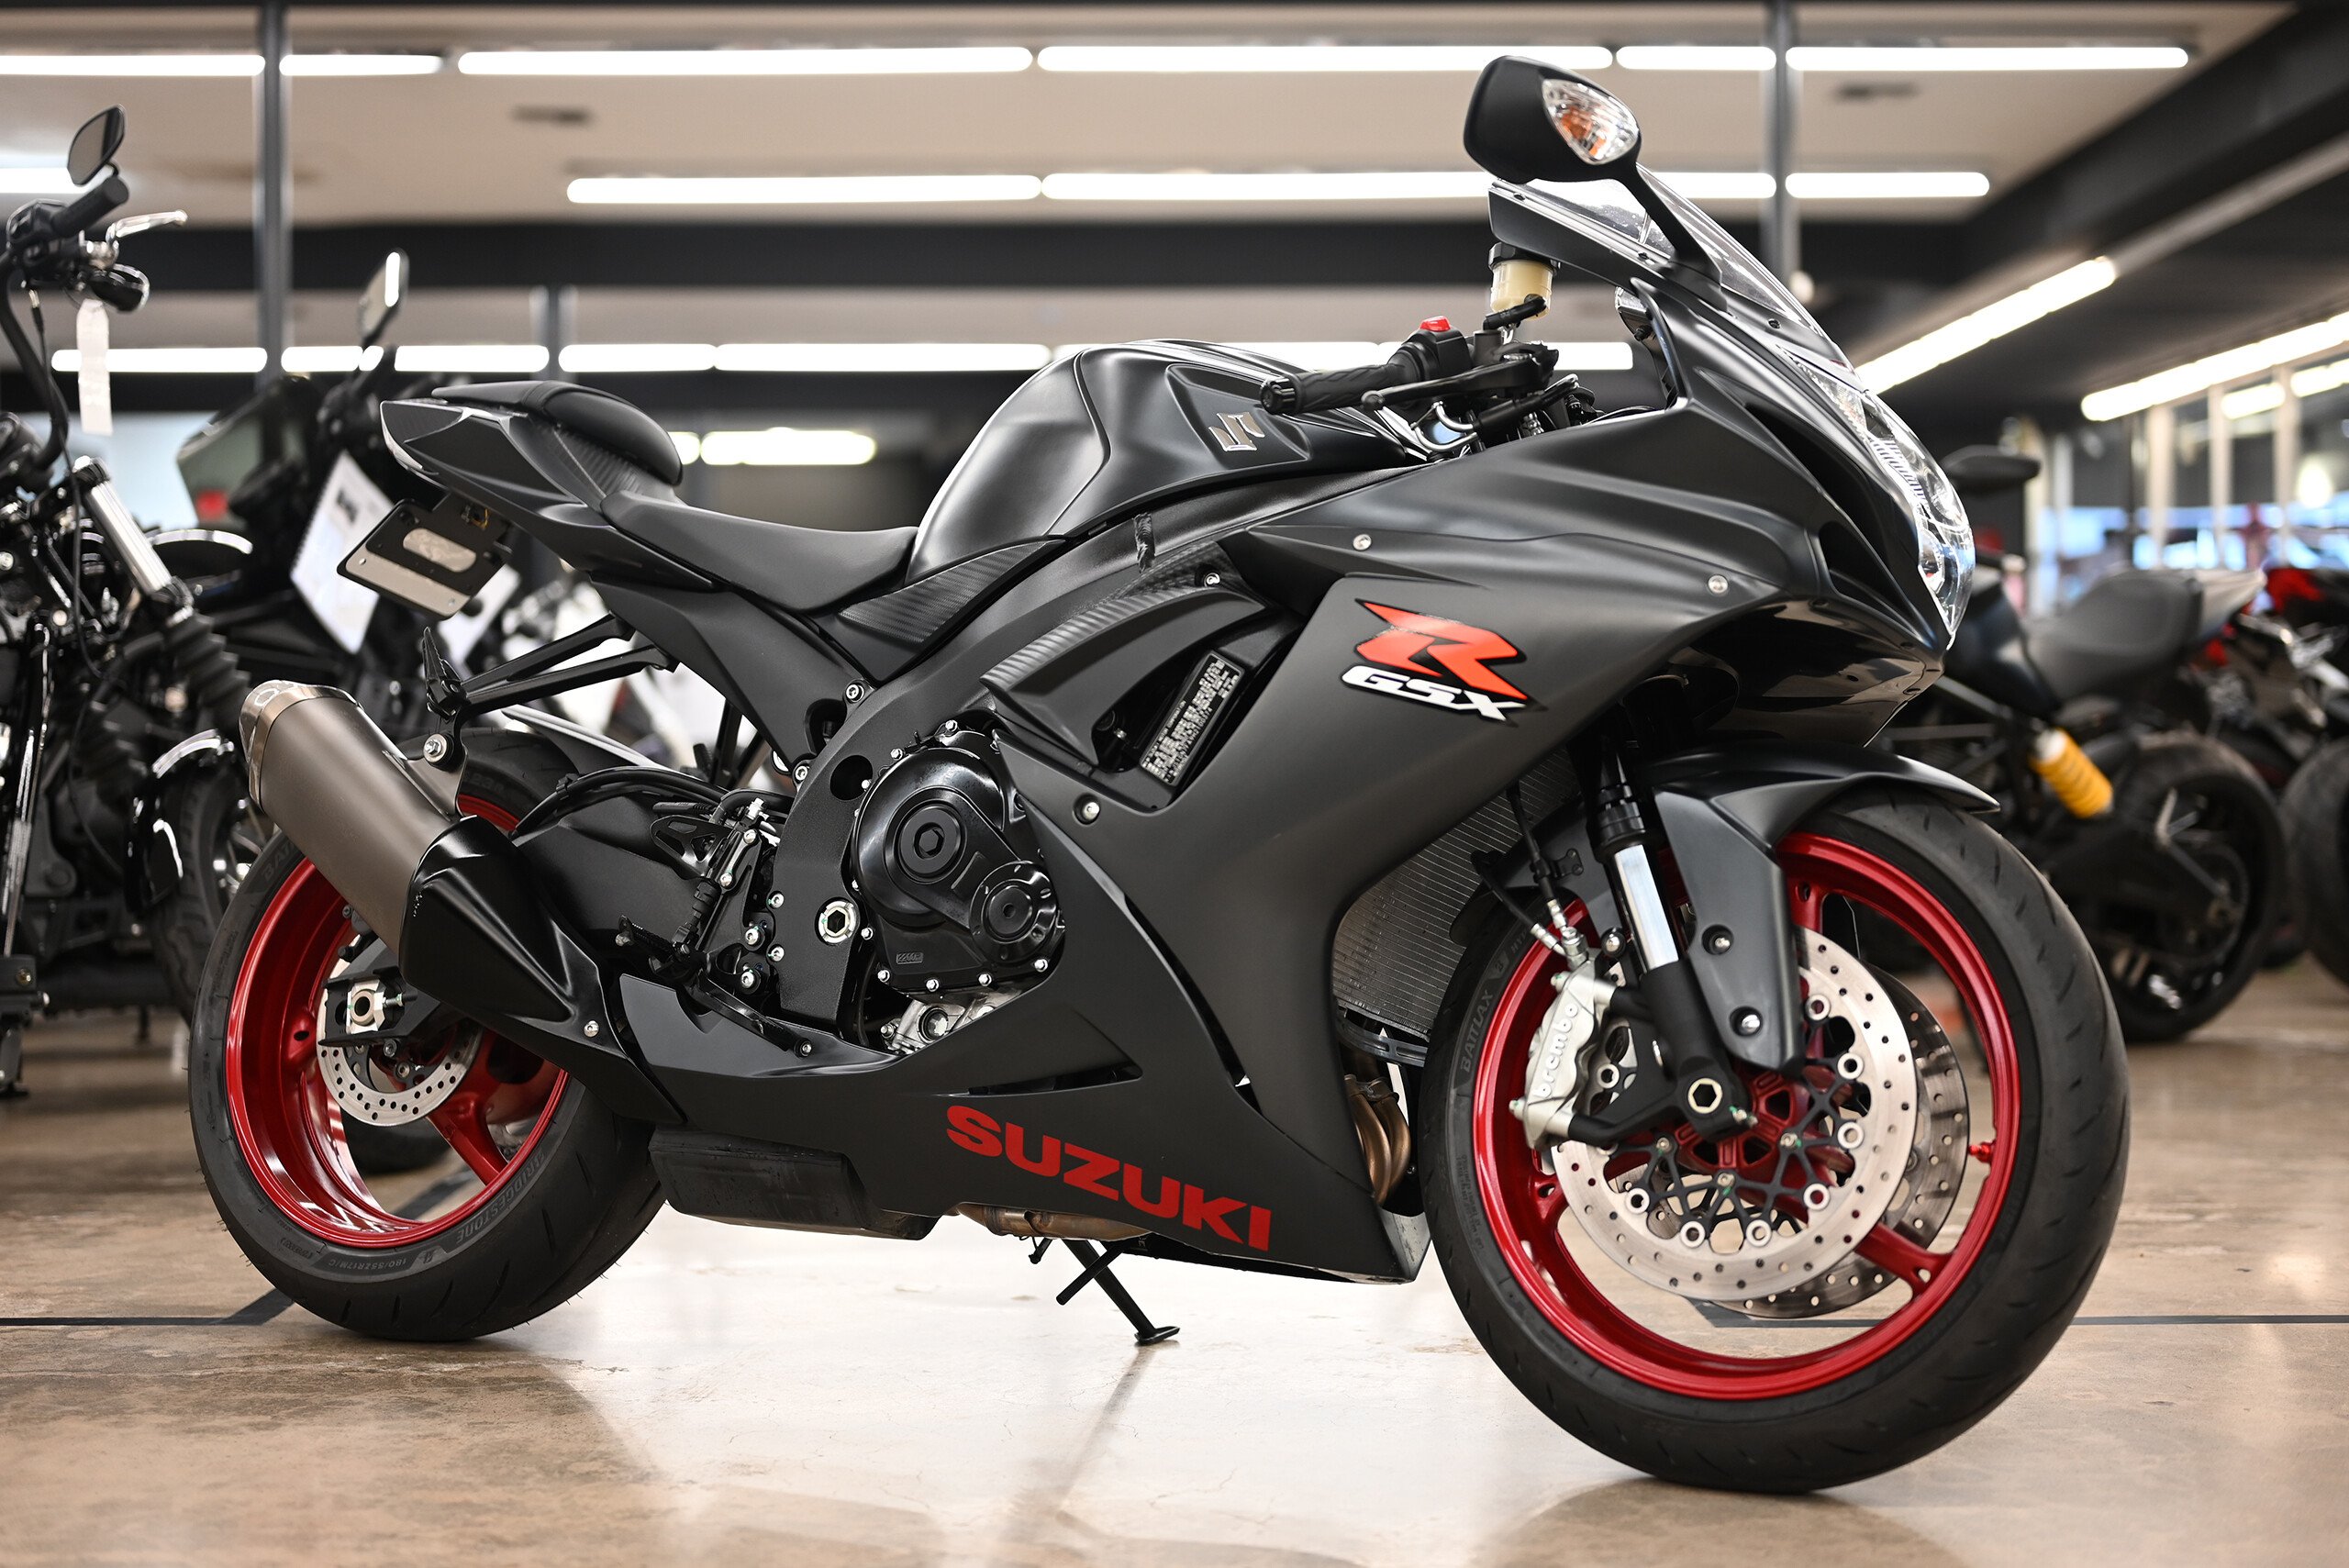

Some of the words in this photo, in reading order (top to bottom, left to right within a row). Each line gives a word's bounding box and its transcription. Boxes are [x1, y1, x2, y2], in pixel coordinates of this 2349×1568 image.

[1341, 664, 1527, 722] GSX
[1357, 601, 1529, 701] R
[1461, 989, 1494, 1073] BATTLAX
[1531, 1002, 1579, 1098] brembo
[456, 1152, 546, 1242] BRIDGESTONE
[946, 1105, 1272, 1252] SUZUKI
